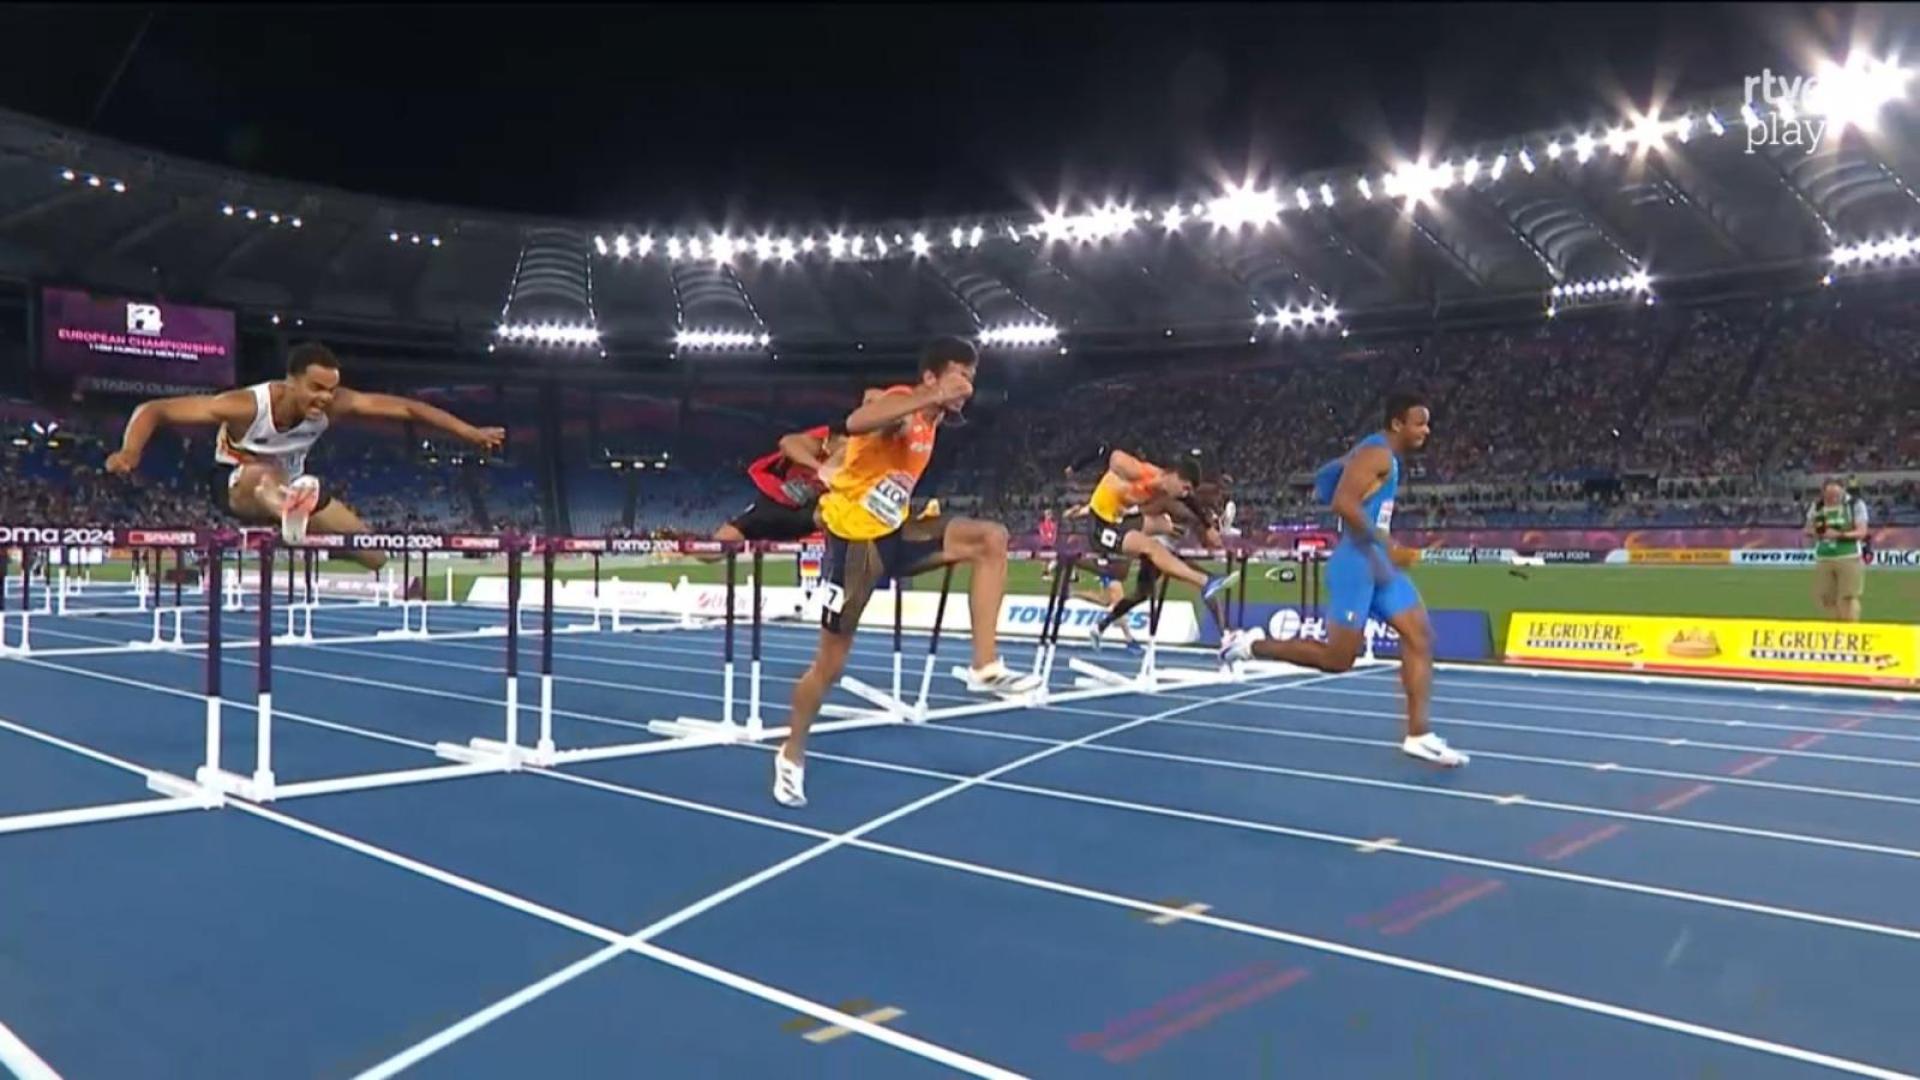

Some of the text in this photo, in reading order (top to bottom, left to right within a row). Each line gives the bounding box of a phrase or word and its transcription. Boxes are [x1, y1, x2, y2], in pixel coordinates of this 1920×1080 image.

[58, 328, 225, 356] EUROPEAN CHAMPIONSHIPS
[63, 528, 116, 544] 2024
[353, 534, 405, 549] roma
[407, 534, 443, 549] 2024
[612, 539, 650, 551] roma
[1740, 552, 1782, 562] TOYO
[1529, 622, 1548, 637] LE
[1752, 629, 1873, 652] LE GRUYÈRE
